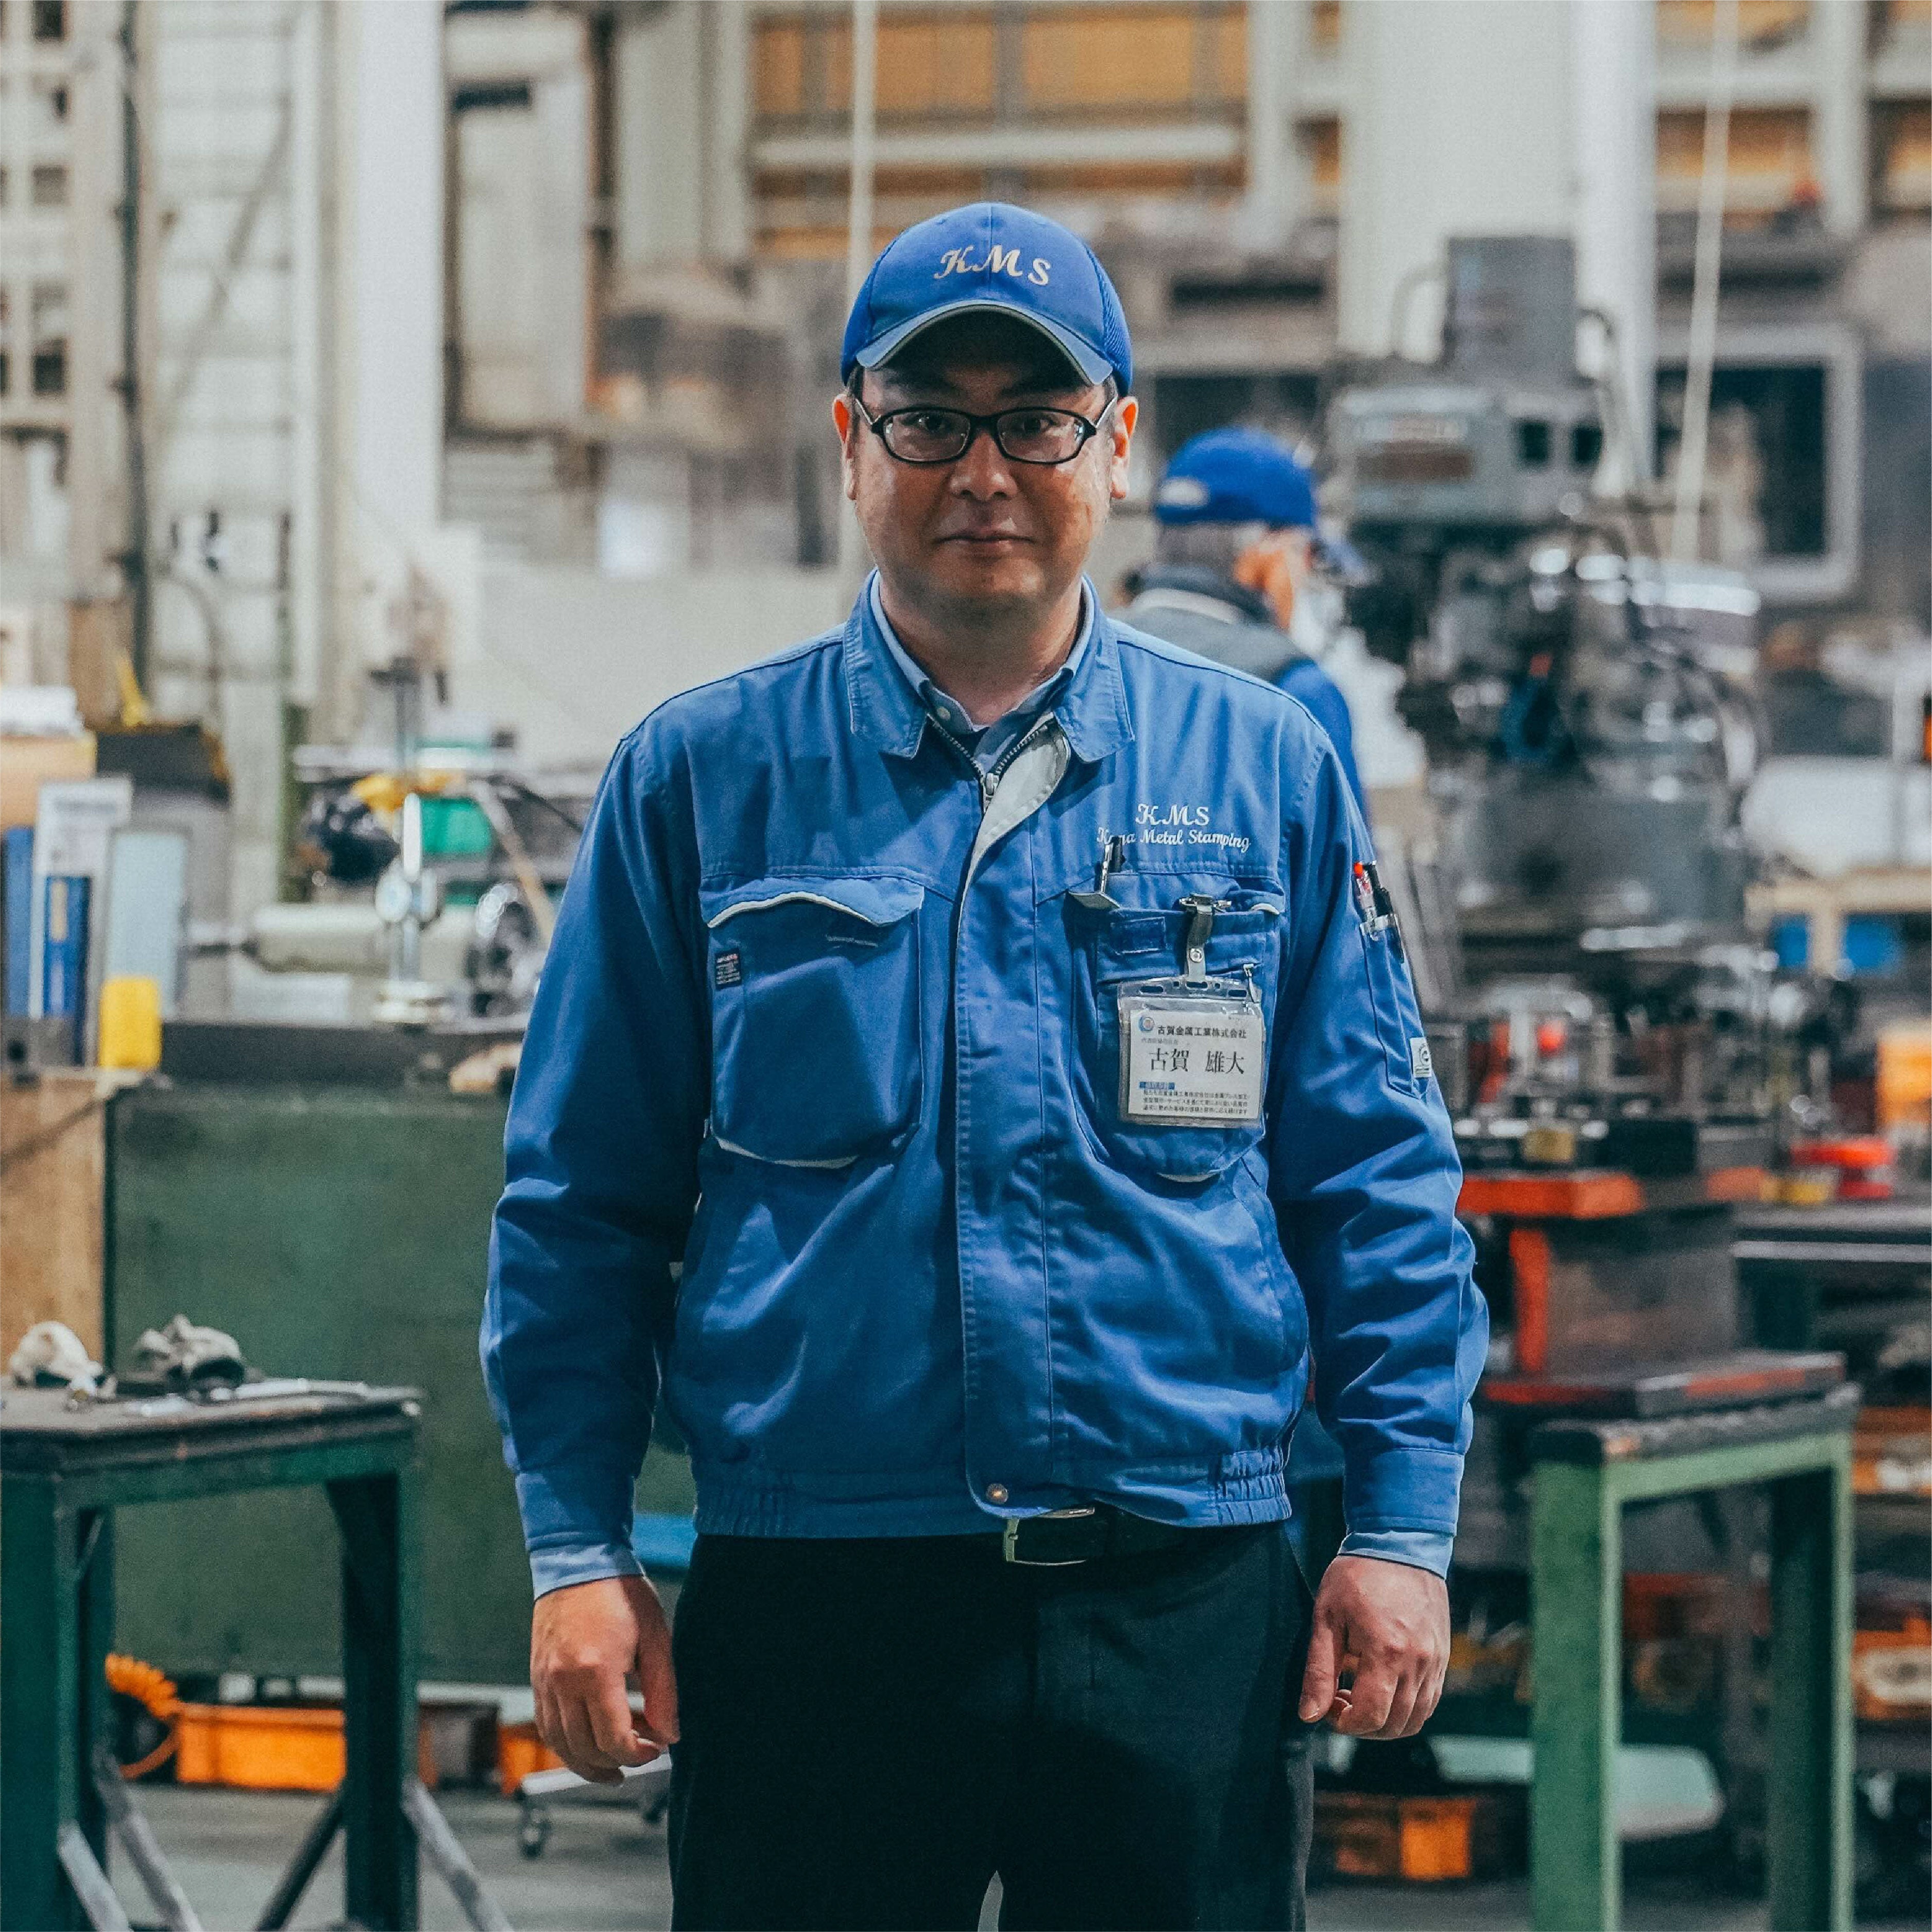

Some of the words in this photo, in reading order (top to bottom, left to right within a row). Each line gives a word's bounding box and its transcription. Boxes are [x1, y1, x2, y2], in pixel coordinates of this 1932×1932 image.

[1140, 829, 1185, 845] Metal
[1188, 829, 1251, 852] Stamping
[1149, 1048, 1189, 1072] 古賀
[1205, 1050, 1245, 1075] 雄大
